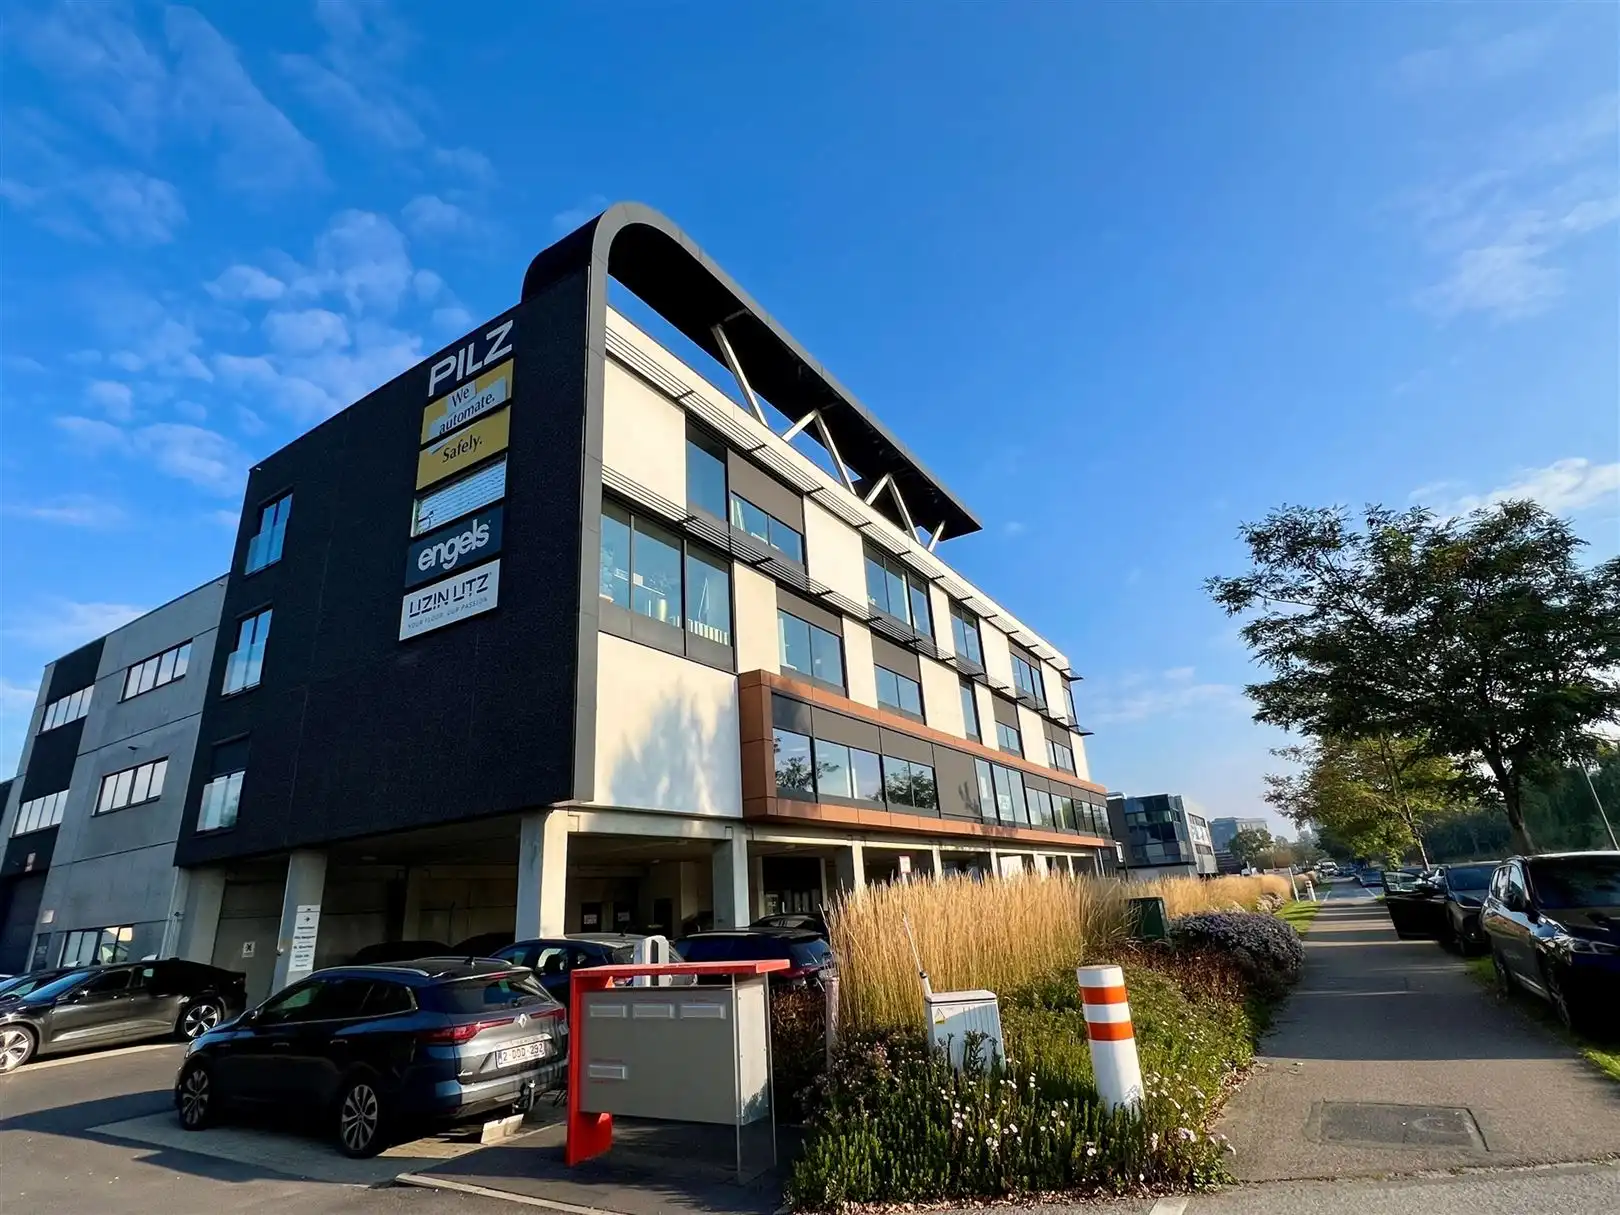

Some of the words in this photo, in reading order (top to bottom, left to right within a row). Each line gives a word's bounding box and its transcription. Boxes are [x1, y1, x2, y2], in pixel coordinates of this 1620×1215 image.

[428, 319, 513, 397] PILZ
[438, 392, 496, 434] automate.
[451, 386, 470, 408] We
[442, 433, 483, 463] Safely.
[417, 519, 490, 571] engels
